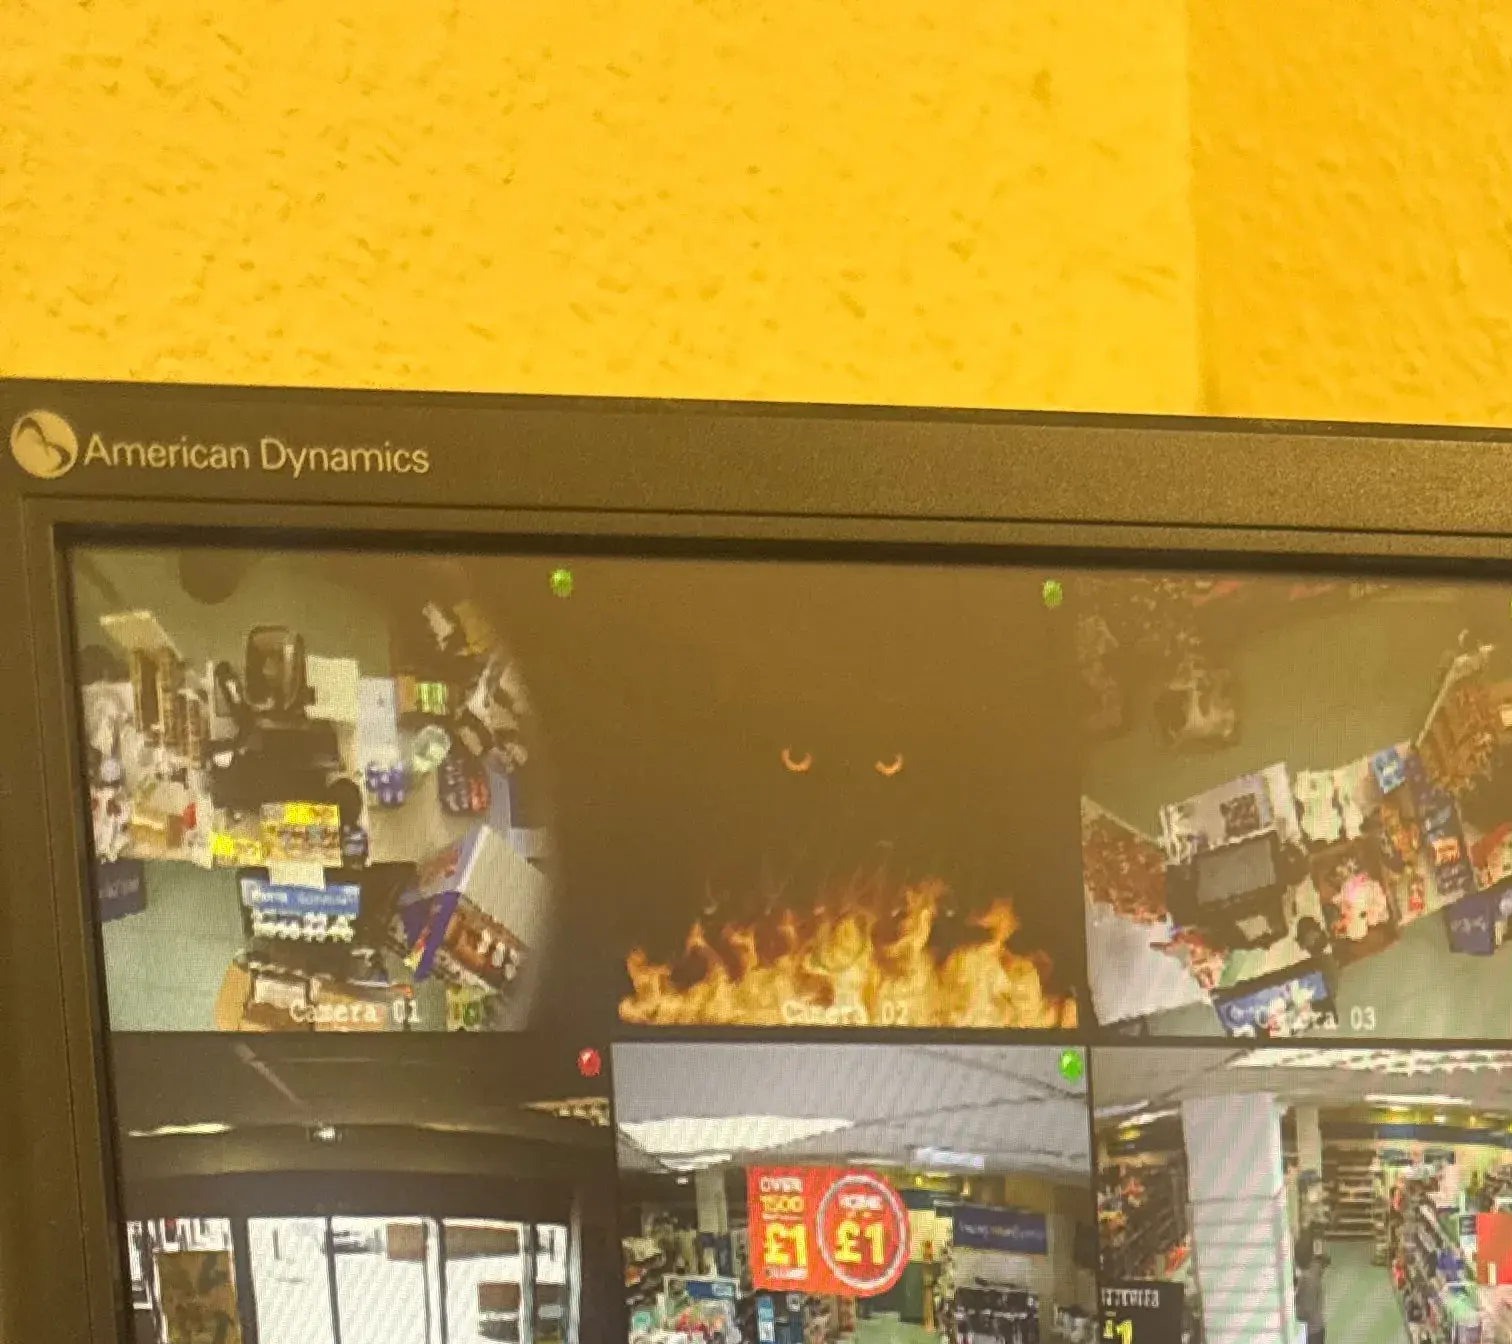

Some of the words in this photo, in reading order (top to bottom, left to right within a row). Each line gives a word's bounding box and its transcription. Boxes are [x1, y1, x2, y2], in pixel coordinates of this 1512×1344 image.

[84, 433, 250, 471] American
[260, 436, 430, 478] Dynamics
[289, 998, 385, 1024] Camera
[392, 996, 420, 1025] 01
[781, 1000, 867, 1023] Camera
[881, 1000, 910, 1024] 02
[1350, 1005, 1376, 1031] 03
[764, 1221, 808, 1268] £1
[834, 1220, 886, 1266] £1
